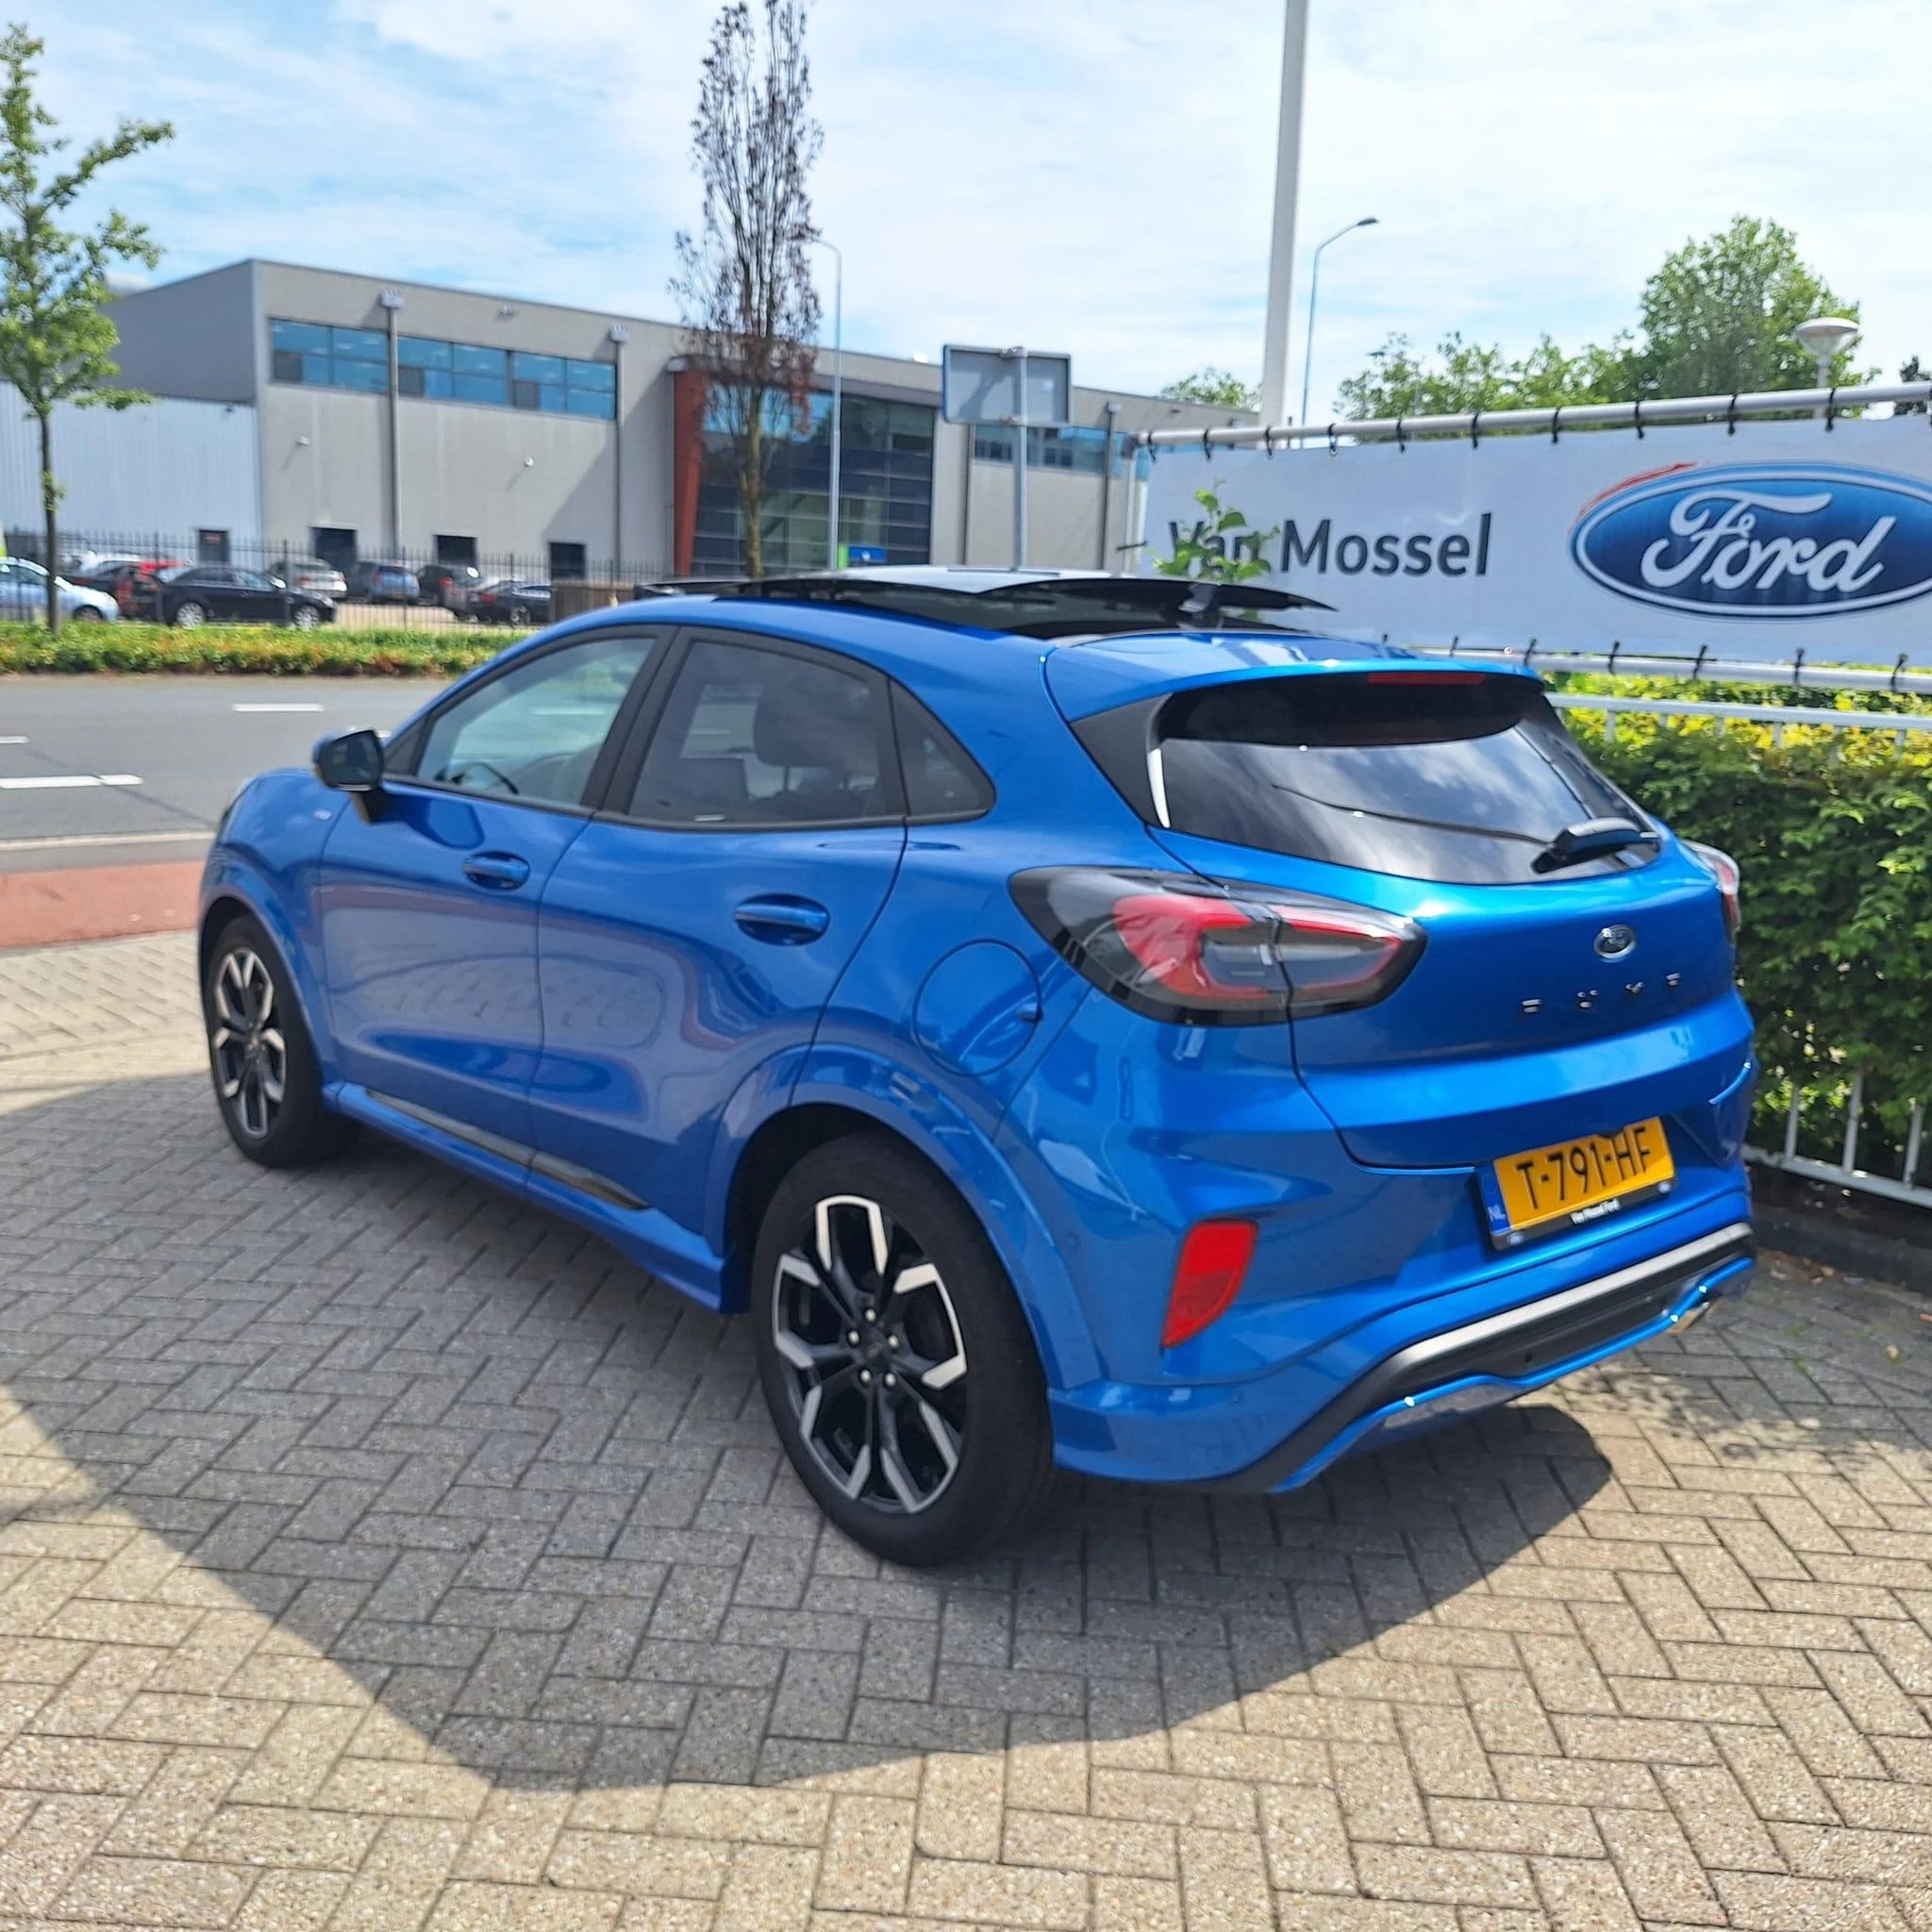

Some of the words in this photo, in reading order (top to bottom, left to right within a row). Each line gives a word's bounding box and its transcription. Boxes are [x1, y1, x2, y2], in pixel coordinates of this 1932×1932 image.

[1280, 512, 1492, 576] Mossel
[1641, 490, 1897, 592] Ford
[1516, 1126, 1652, 1210] T-791-HF
[1487, 1204, 1507, 1223] NL
